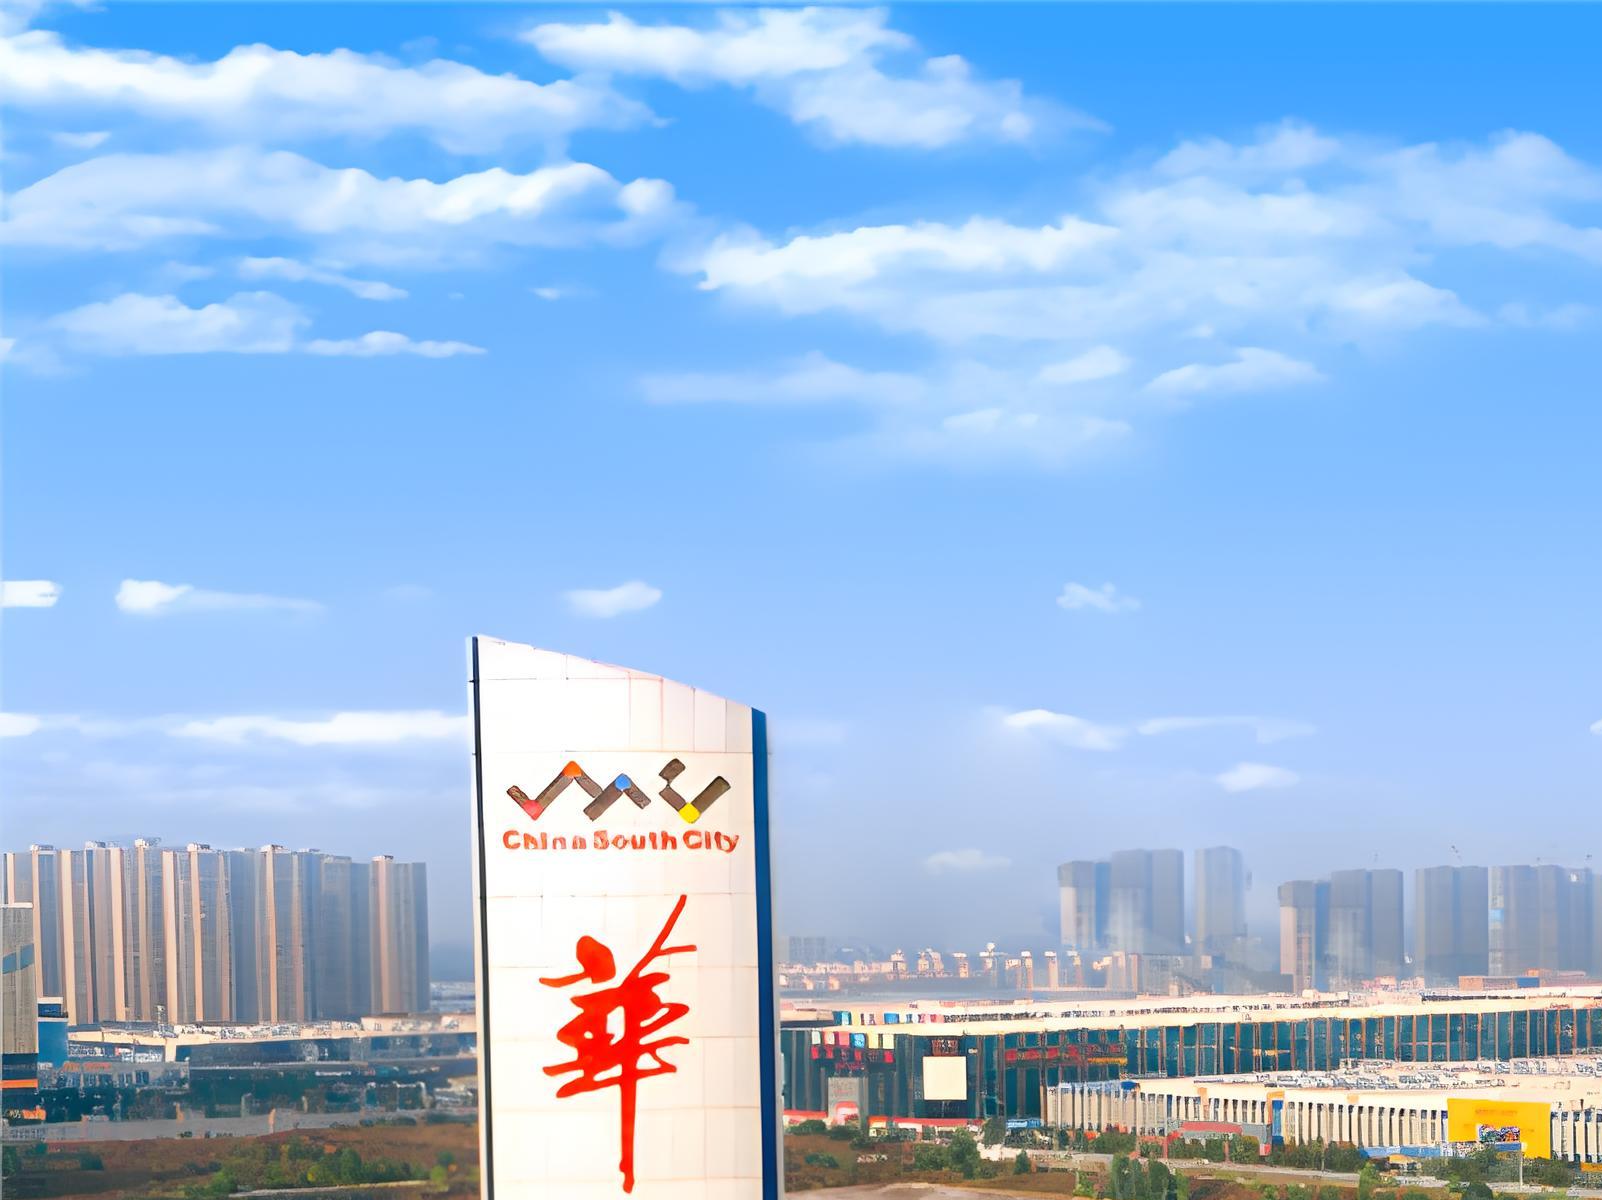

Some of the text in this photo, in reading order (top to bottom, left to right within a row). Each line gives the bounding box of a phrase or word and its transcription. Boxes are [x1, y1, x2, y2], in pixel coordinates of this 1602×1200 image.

[503, 830, 740, 853] China South City
